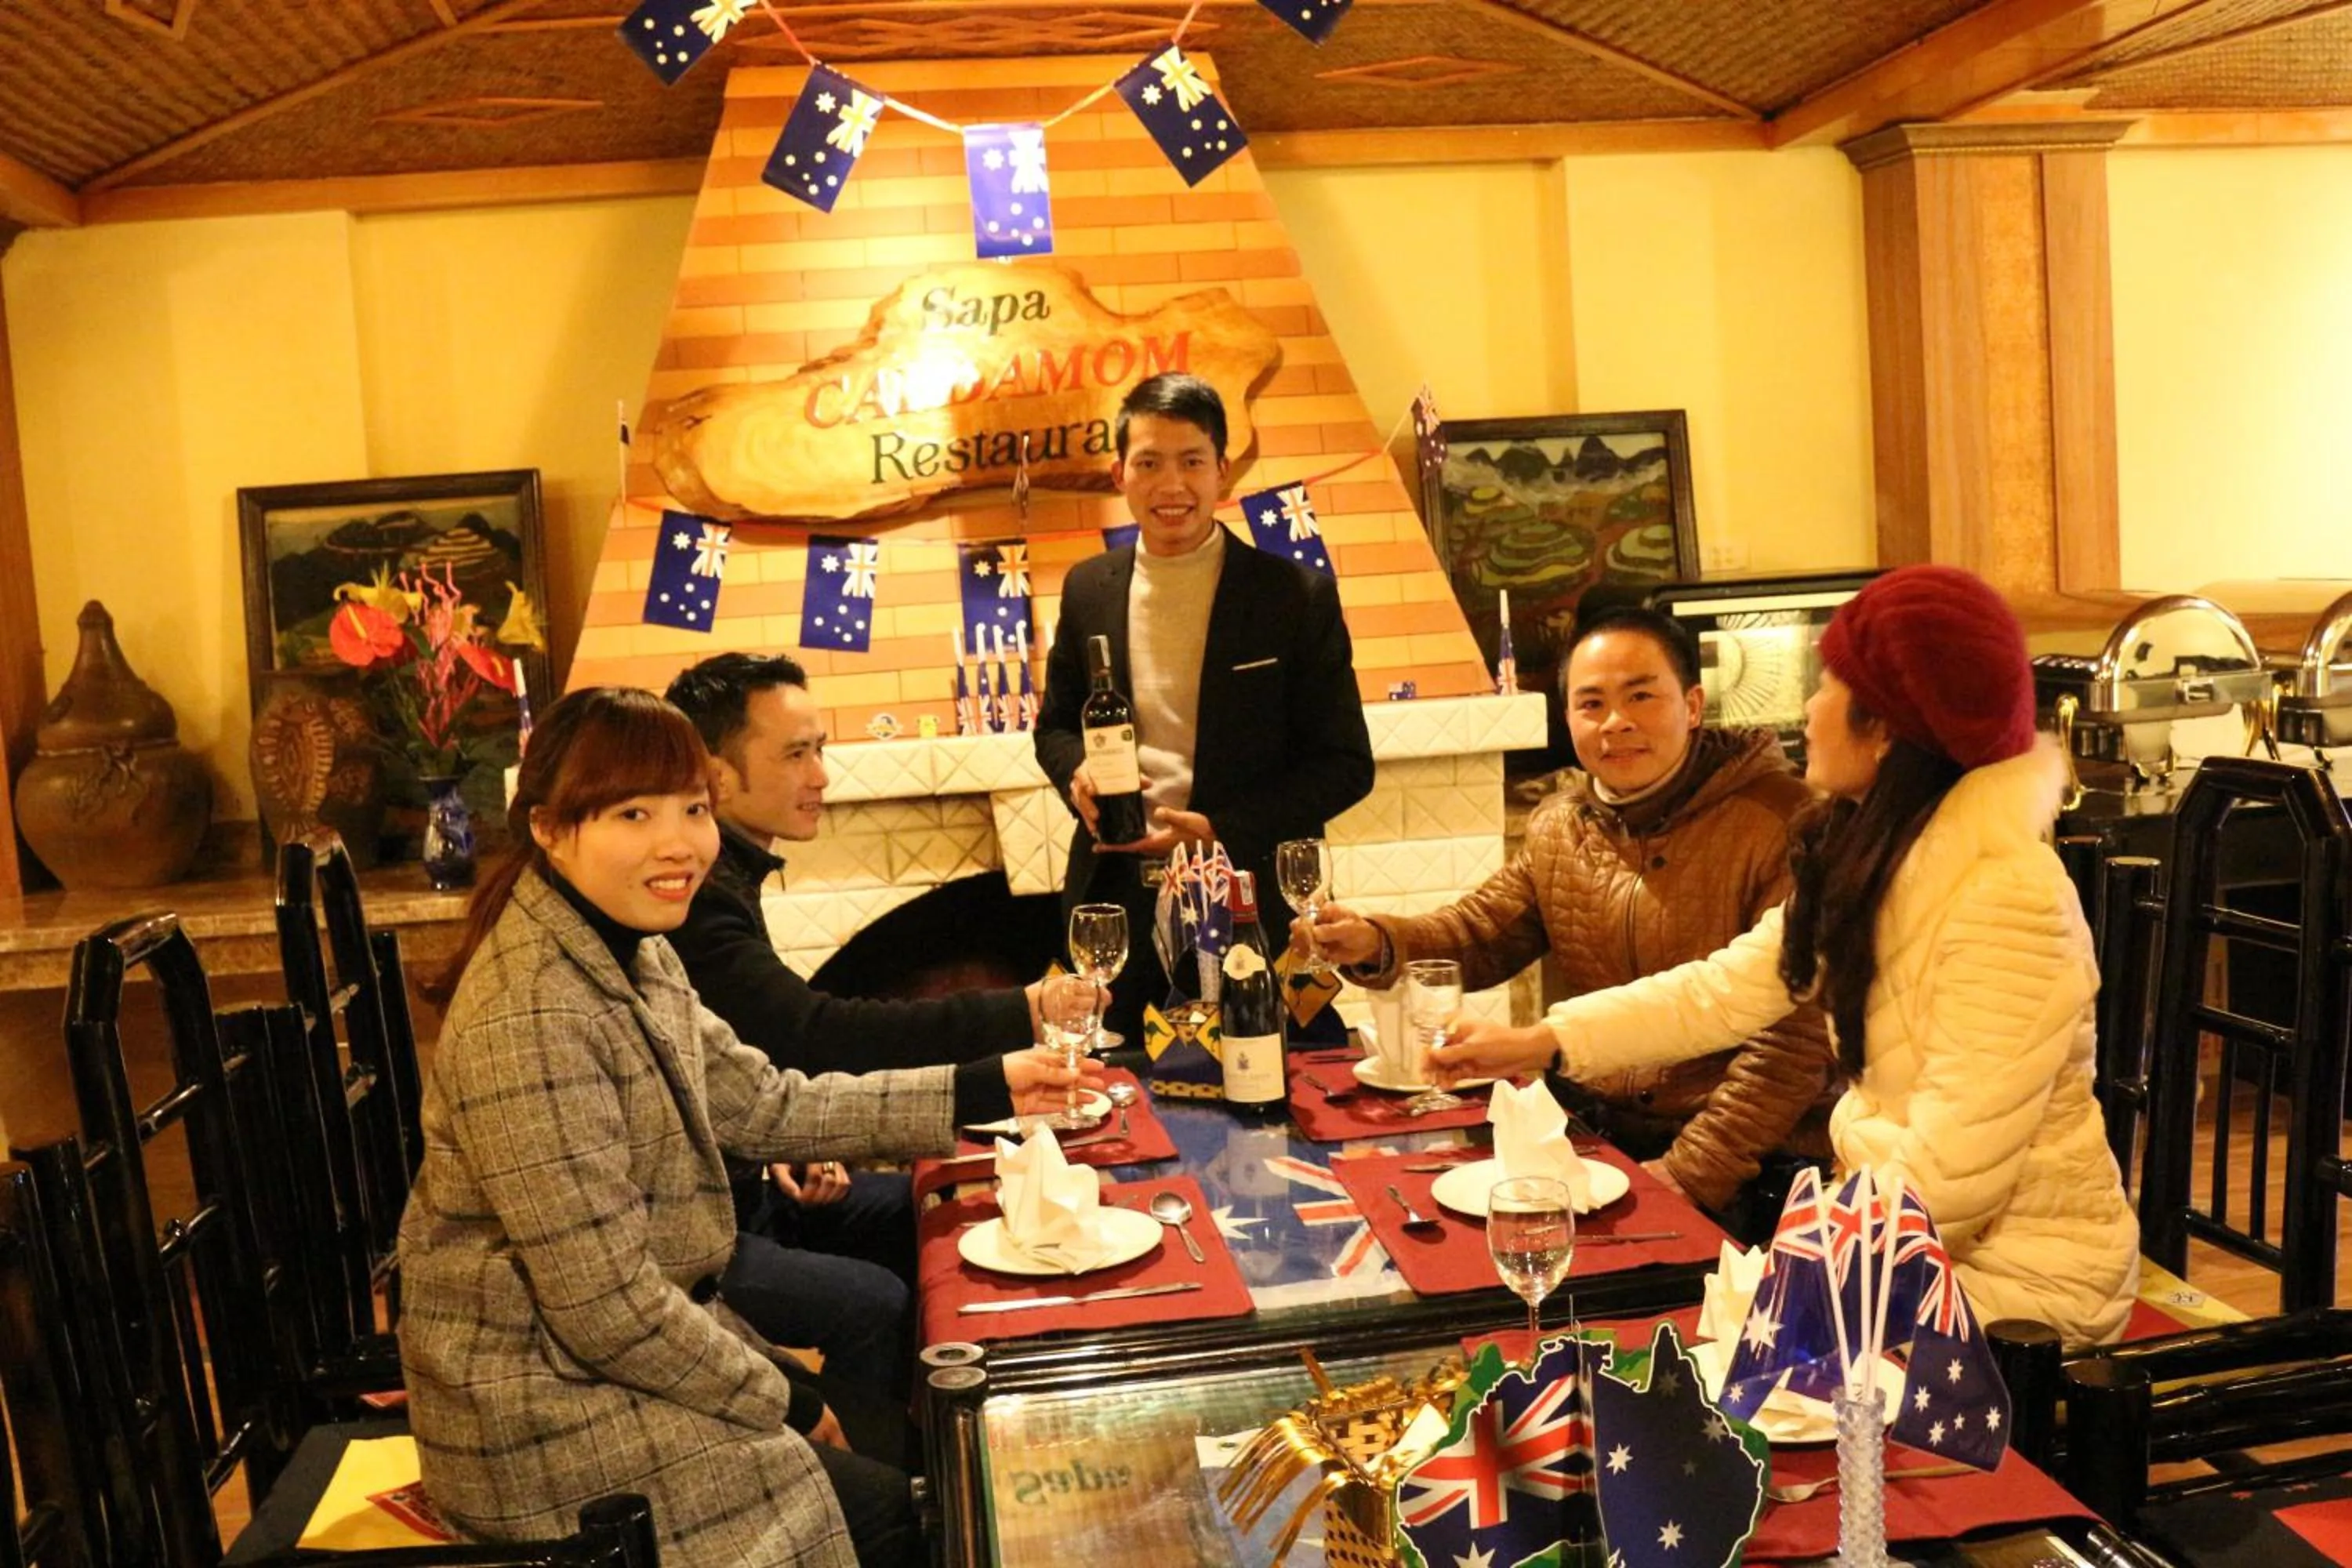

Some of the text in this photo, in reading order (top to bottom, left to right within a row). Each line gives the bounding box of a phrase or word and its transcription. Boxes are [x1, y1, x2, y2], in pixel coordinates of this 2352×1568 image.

[921, 286, 1051, 336] Sapa
[804, 332, 1192, 429] CADAMOM
[871, 418, 1116, 485] Restaura
